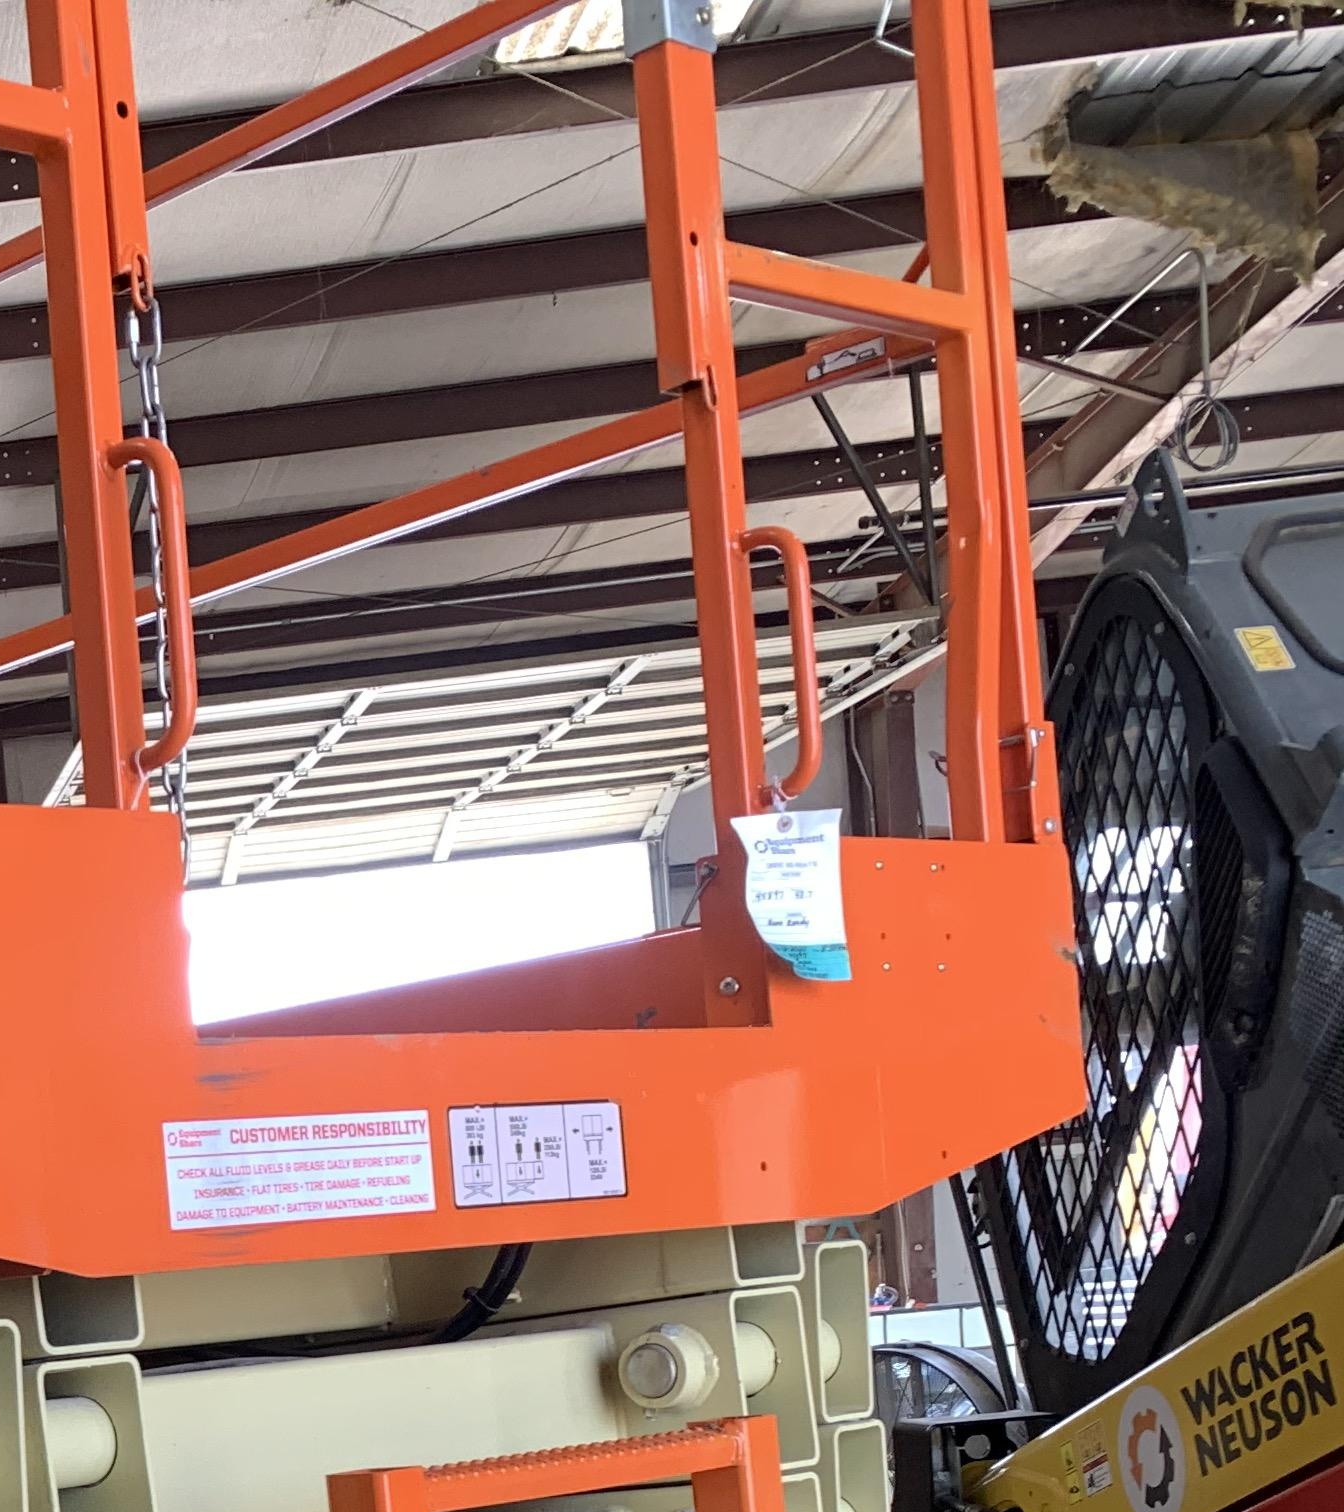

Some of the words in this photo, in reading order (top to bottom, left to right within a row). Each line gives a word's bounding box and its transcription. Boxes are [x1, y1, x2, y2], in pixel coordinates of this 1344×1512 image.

[229, 1126, 309, 1144] CUSTOMER
[311, 1119, 426, 1140] RESPONSIBILITY
[177, 1168, 207, 1179] CHECK
[209, 1167, 223, 1177] ALL
[226, 1165, 251, 1177] FLUID
[253, 1163, 283, 1175] LEVELS
[293, 1160, 326, 1172] GREASE
[327, 1159, 351, 1170] DAILY
[353, 1157, 383, 1169] BEFORE
[385, 1155, 409, 1167] START
[411, 1154, 422, 1165] UP
[194, 1186, 245, 1200] INSURANCE
[252, 1184, 272, 1196] FLAT
[274, 1182, 299, 1195] TIRES
[305, 1181, 325, 1192] TIRE
[327, 1178, 360, 1191] DAMAGE
[367, 1175, 411, 1188] REFUELING
[176, 1209, 213, 1222] DAMAGE
[215, 1207, 227, 1219] TO
[229, 1204, 280, 1218] EQUIPMENT
[287, 1200, 323, 1214] BATTERY
[325, 1196, 384, 1211] MAINTENANCE
[390, 1193, 430, 1206] CLEANING
[1180, 1311, 1326, 1426] WACKER
[1194, 1359, 1337, 1477] NEUSON
